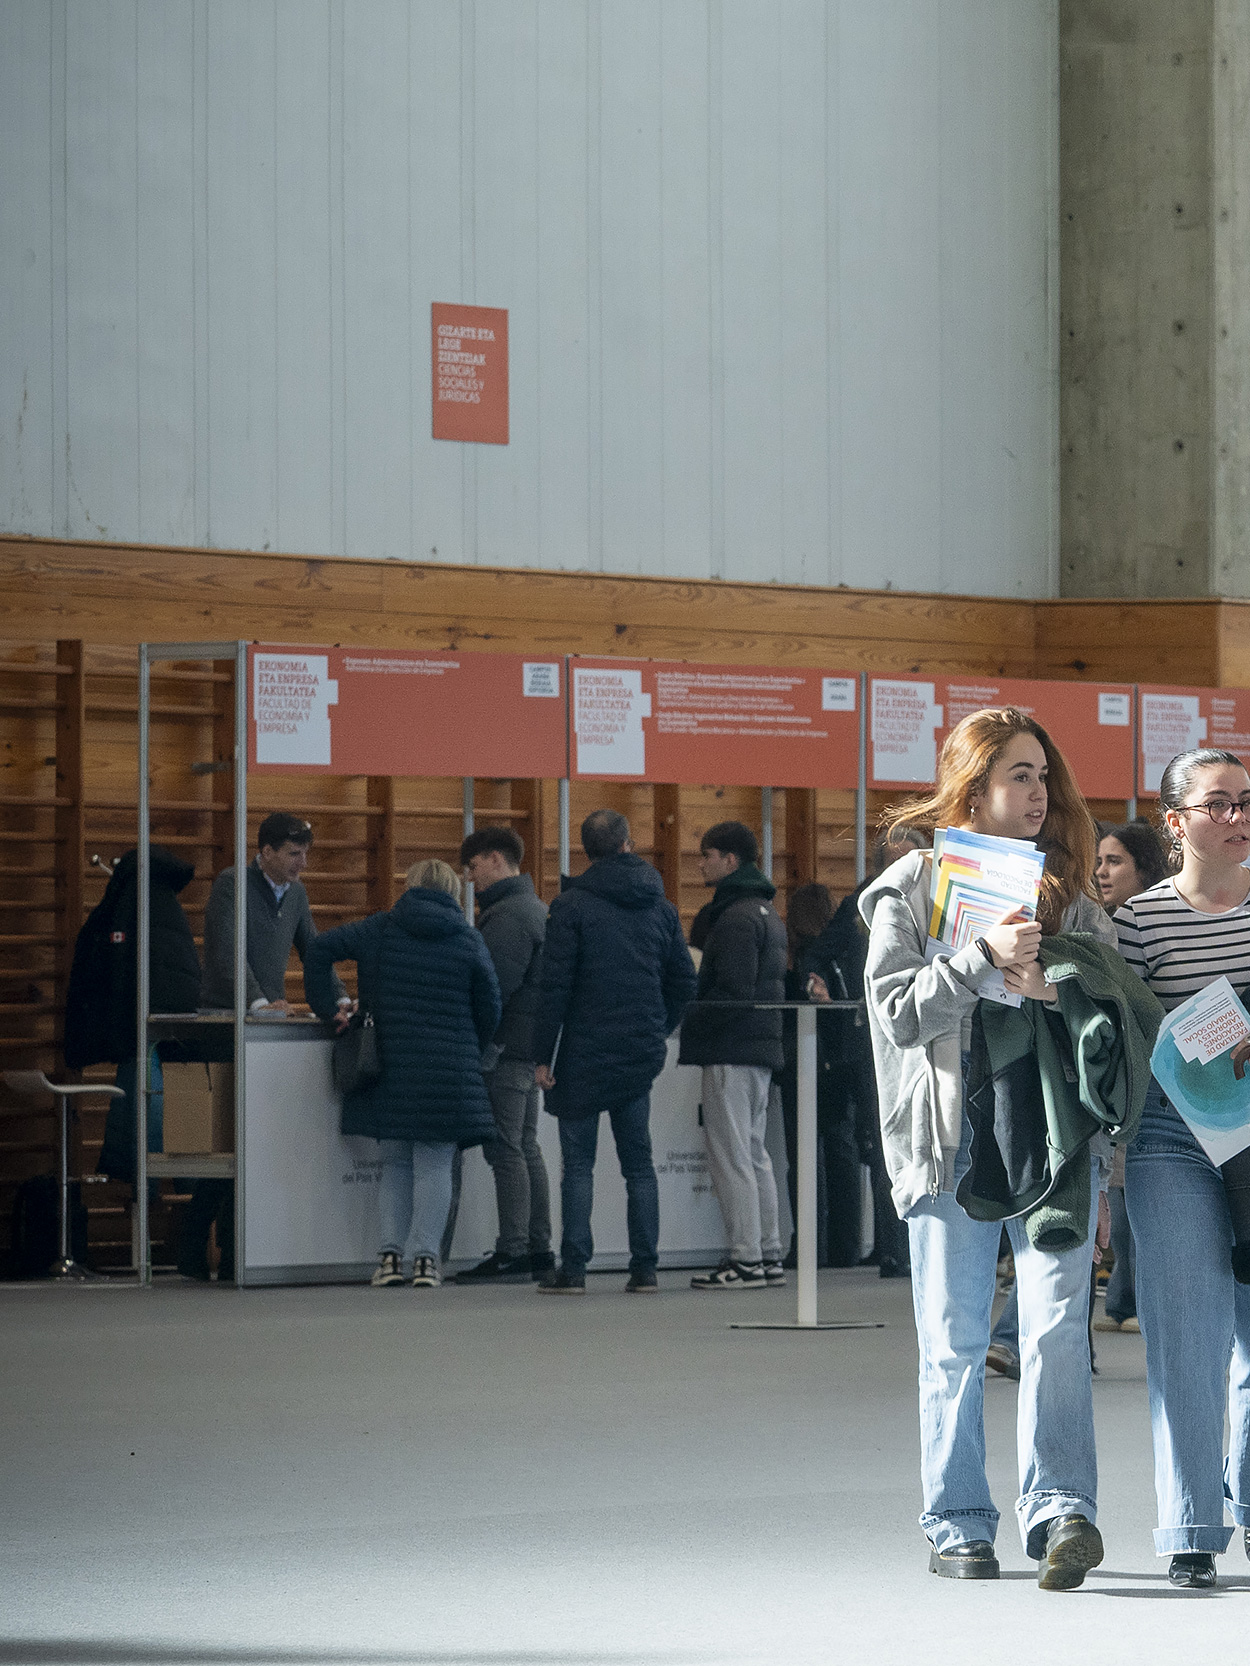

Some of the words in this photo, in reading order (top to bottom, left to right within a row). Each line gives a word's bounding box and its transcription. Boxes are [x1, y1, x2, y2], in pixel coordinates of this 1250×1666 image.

[478, 327, 496, 341] ETA
[258, 660, 309, 673] EKONOMIA
[258, 672, 276, 685] ETA
[579, 675, 623, 688] EKONOMIA
[258, 685, 317, 698] FAKULTATEA
[578, 687, 595, 698] ETA
[258, 698, 300, 711] FACULTAD
[258, 723, 298, 735] EMPRESA
[1206, 1008, 1238, 1031] TRABAJO
[1182, 1024, 1208, 1045] SOCIAL
[1203, 1014, 1241, 1042] LABORALES
[1203, 1020, 1245, 1048] RELACIONES
[1215, 1026, 1249, 1051] FACULTAD
[1206, 1047, 1216, 1057] DE
